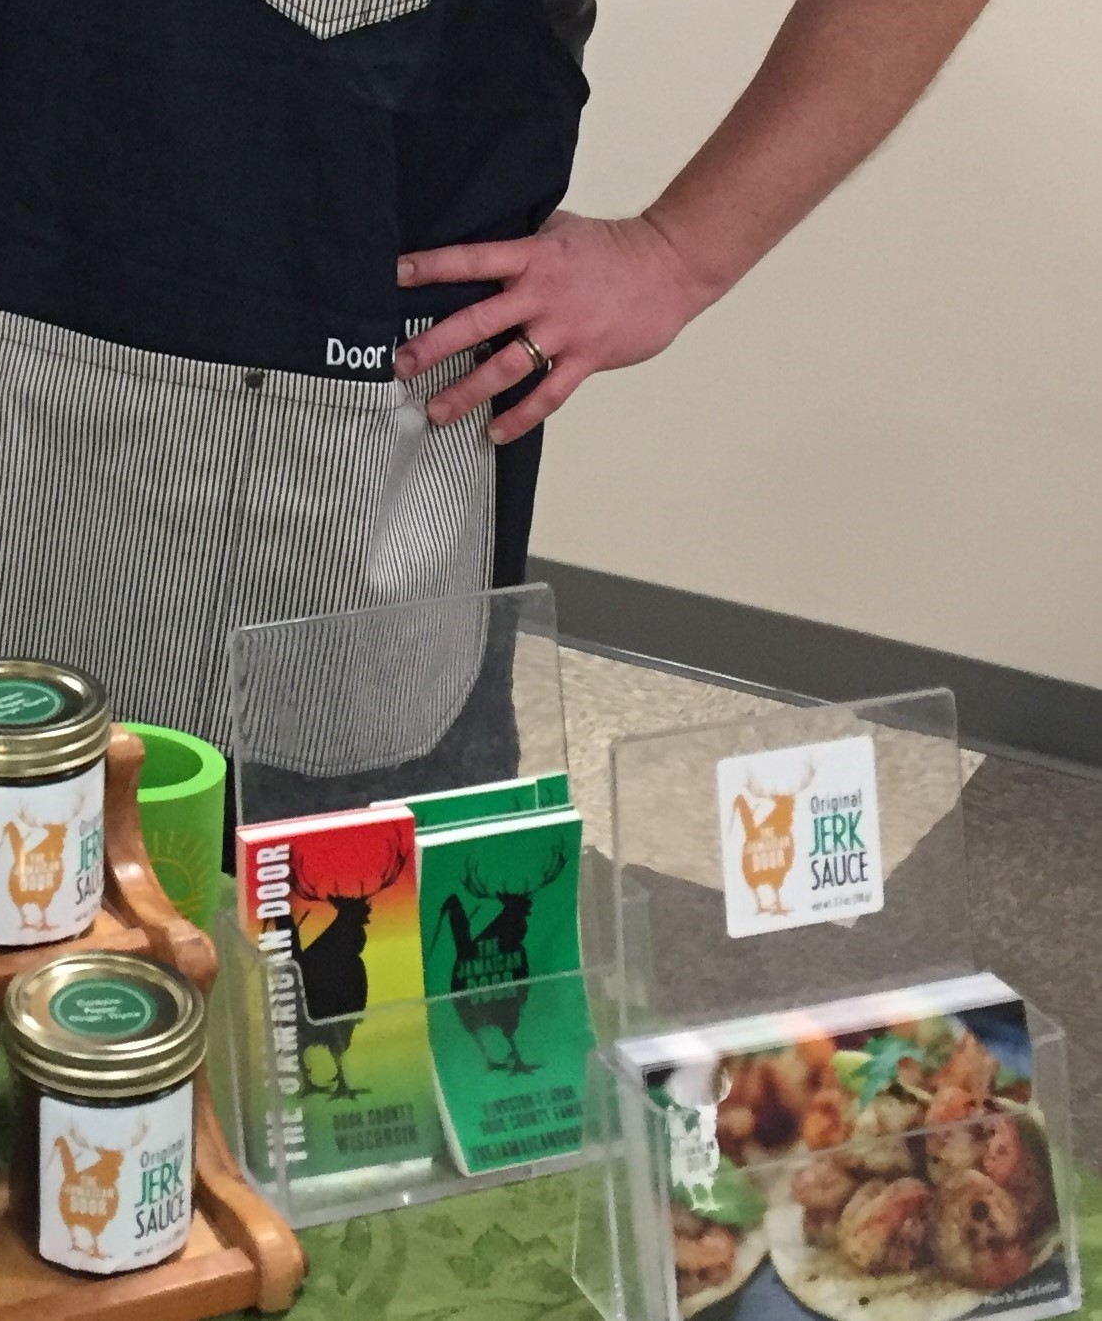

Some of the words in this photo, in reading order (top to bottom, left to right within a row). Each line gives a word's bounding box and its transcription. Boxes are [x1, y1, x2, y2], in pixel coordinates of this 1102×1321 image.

[326, 337, 387, 369] Door
[811, 787, 863, 814] Original
[809, 810, 865, 858] JERK
[256, 843, 291, 920] DOOR
[811, 851, 869, 891] SAUCE
[457, 951, 522, 978] JAMAICAN
[134, 1150, 185, 1208] JERK
[134, 1189, 186, 1240] SAUCE
